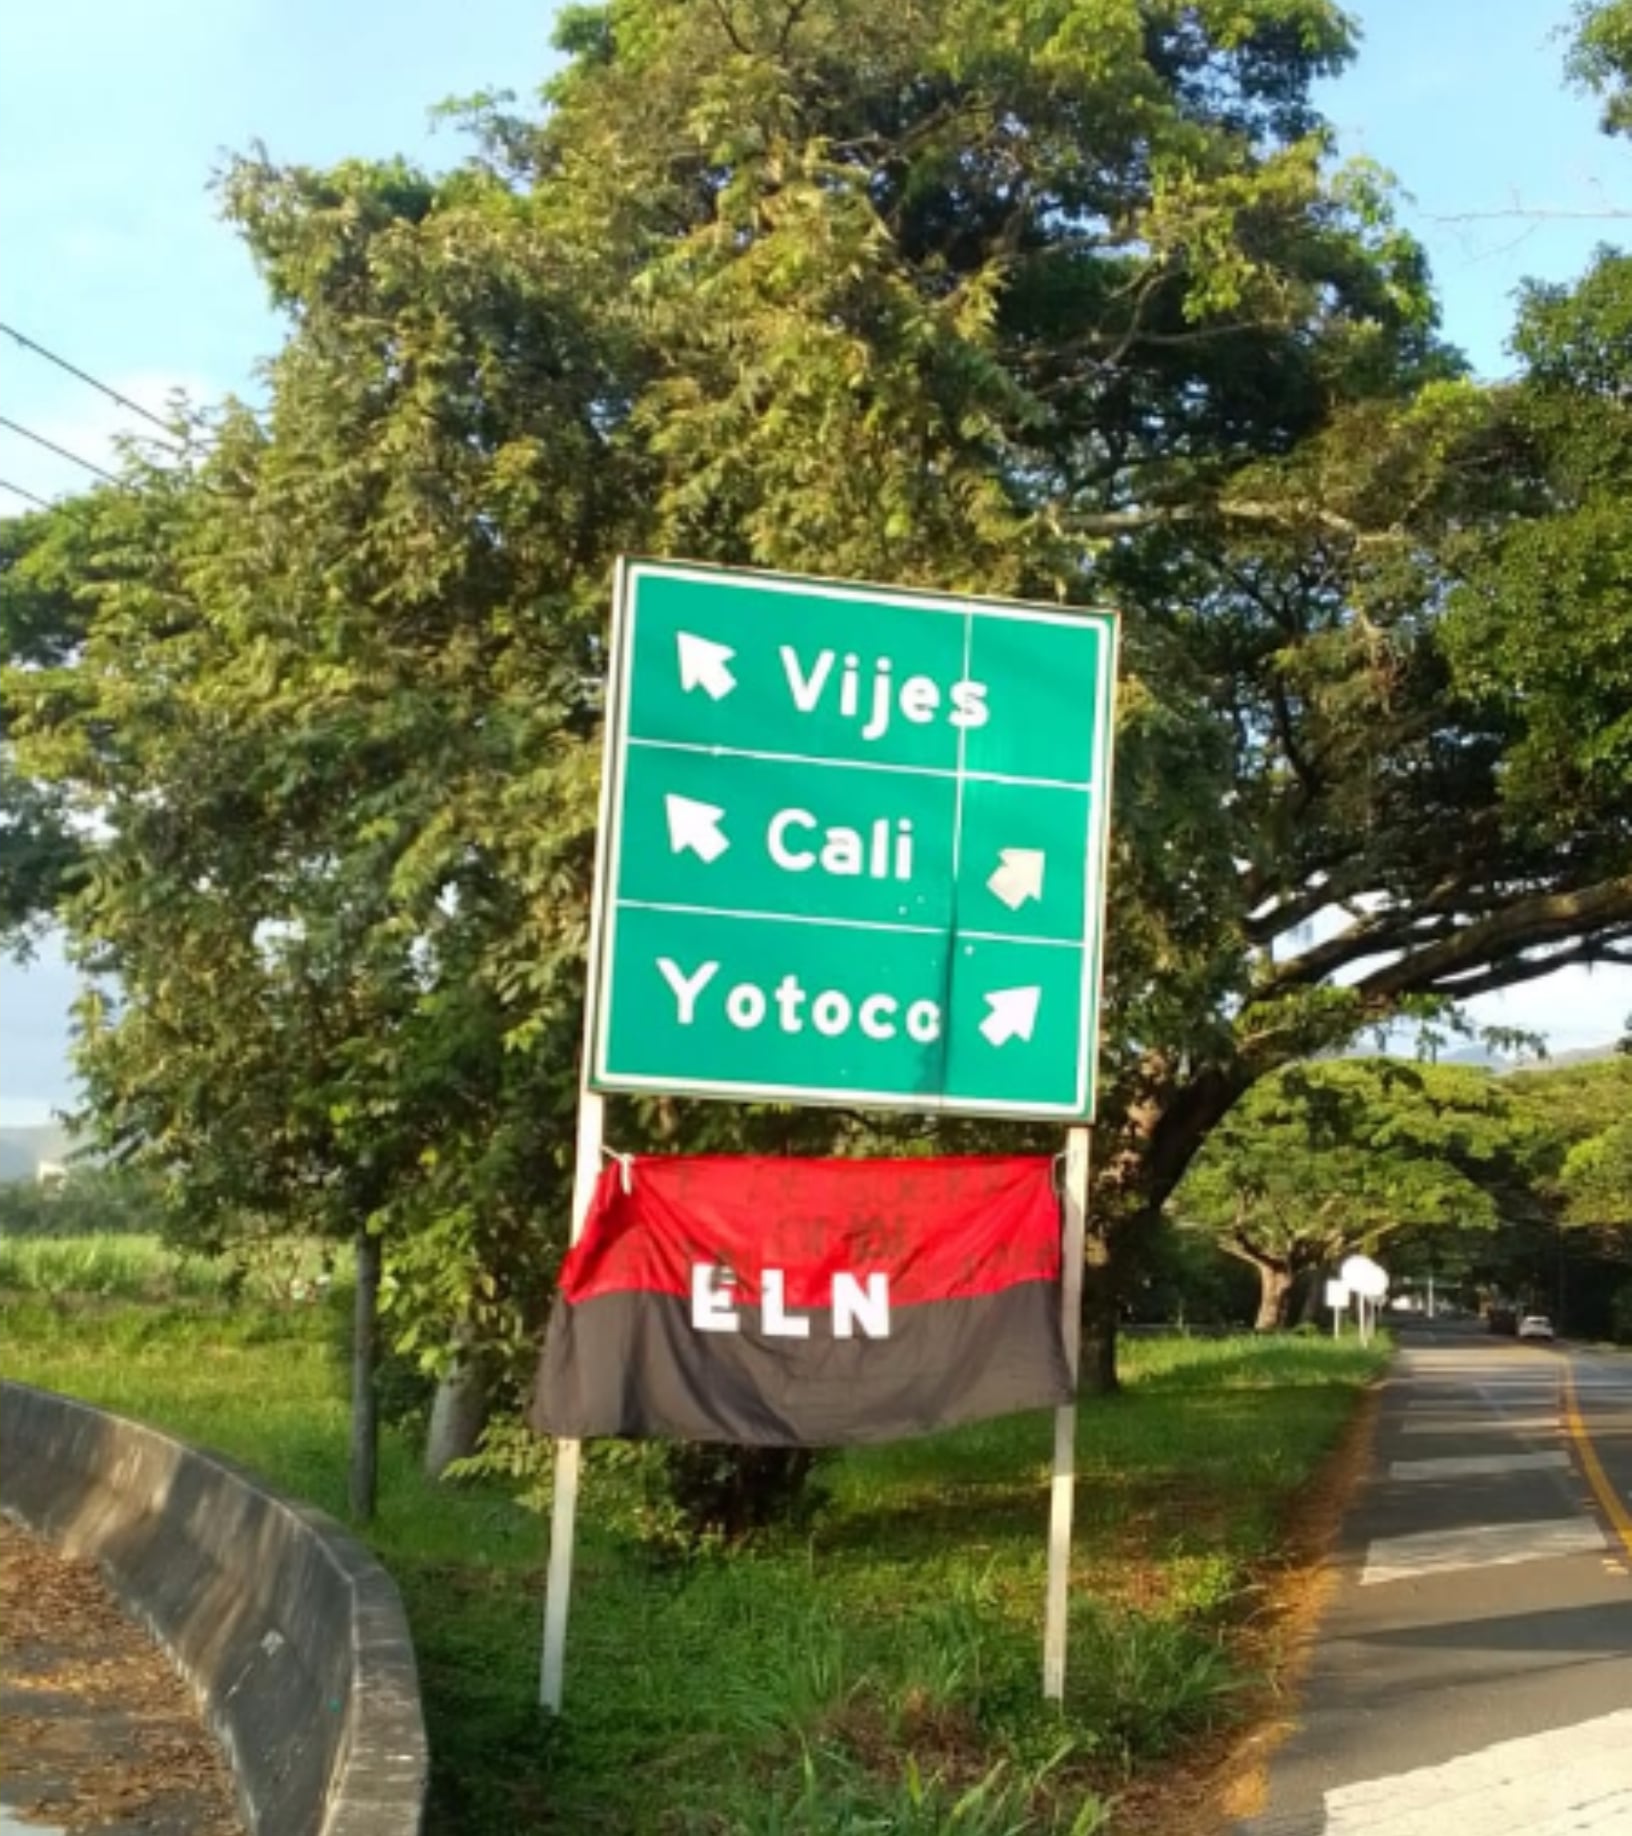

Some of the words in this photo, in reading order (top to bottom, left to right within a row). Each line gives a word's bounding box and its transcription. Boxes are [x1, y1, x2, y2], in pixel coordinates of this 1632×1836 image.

[779, 645, 991, 741] Vijes
[766, 808, 913, 880] Cali
[656, 956, 941, 1043] Yotoco
[691, 1261, 891, 1339] ELN
